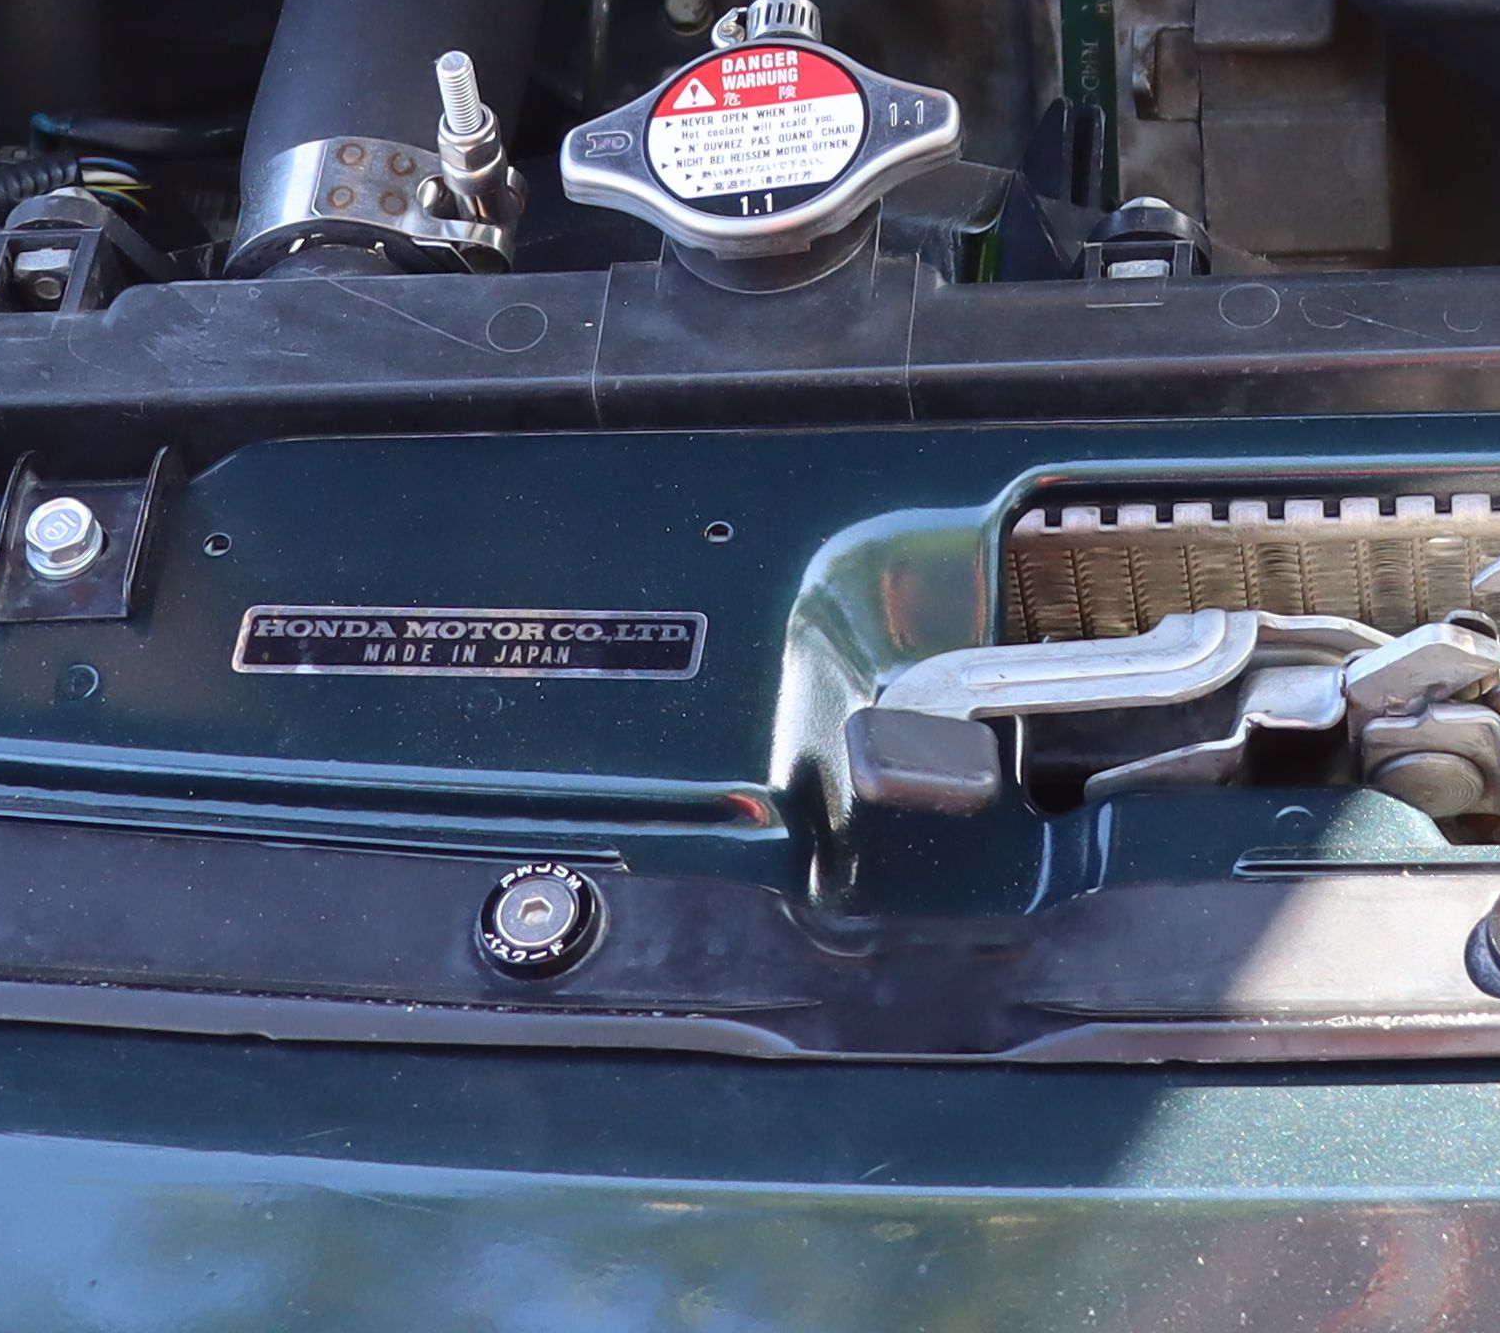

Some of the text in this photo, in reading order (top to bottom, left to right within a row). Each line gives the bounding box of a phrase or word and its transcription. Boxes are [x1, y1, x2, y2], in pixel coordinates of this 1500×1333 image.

[722, 50, 799, 74] DANGER
[722, 68, 799, 91] WARNUNG
[680, 103, 817, 128] NEVER OPEN WHEN HOT.
[888, 99, 926, 129] 1.1
[681, 128, 700, 140] Hot
[706, 125, 746, 137] coolant
[751, 121, 772, 133] will
[779, 116, 807, 128] scald
[702, 138, 743, 151] OUVREZ
[749, 134, 771, 146] PAS
[777, 129, 813, 142] QUAND
[675, 156, 705, 169] NICHT
[708, 153, 726, 165] BEI
[729, 149, 772, 162] HEISSEM
[775, 145, 808, 157] MOTOR
[739, 192, 774, 216] 1.1
[254, 618, 398, 640] HONDA
[401, 620, 547, 641] MOTOR
[362, 643, 572, 665] MADE IN JAPAN
[499, 861, 583, 891] PWJDM
[483, 932, 564, 963] パスワード
